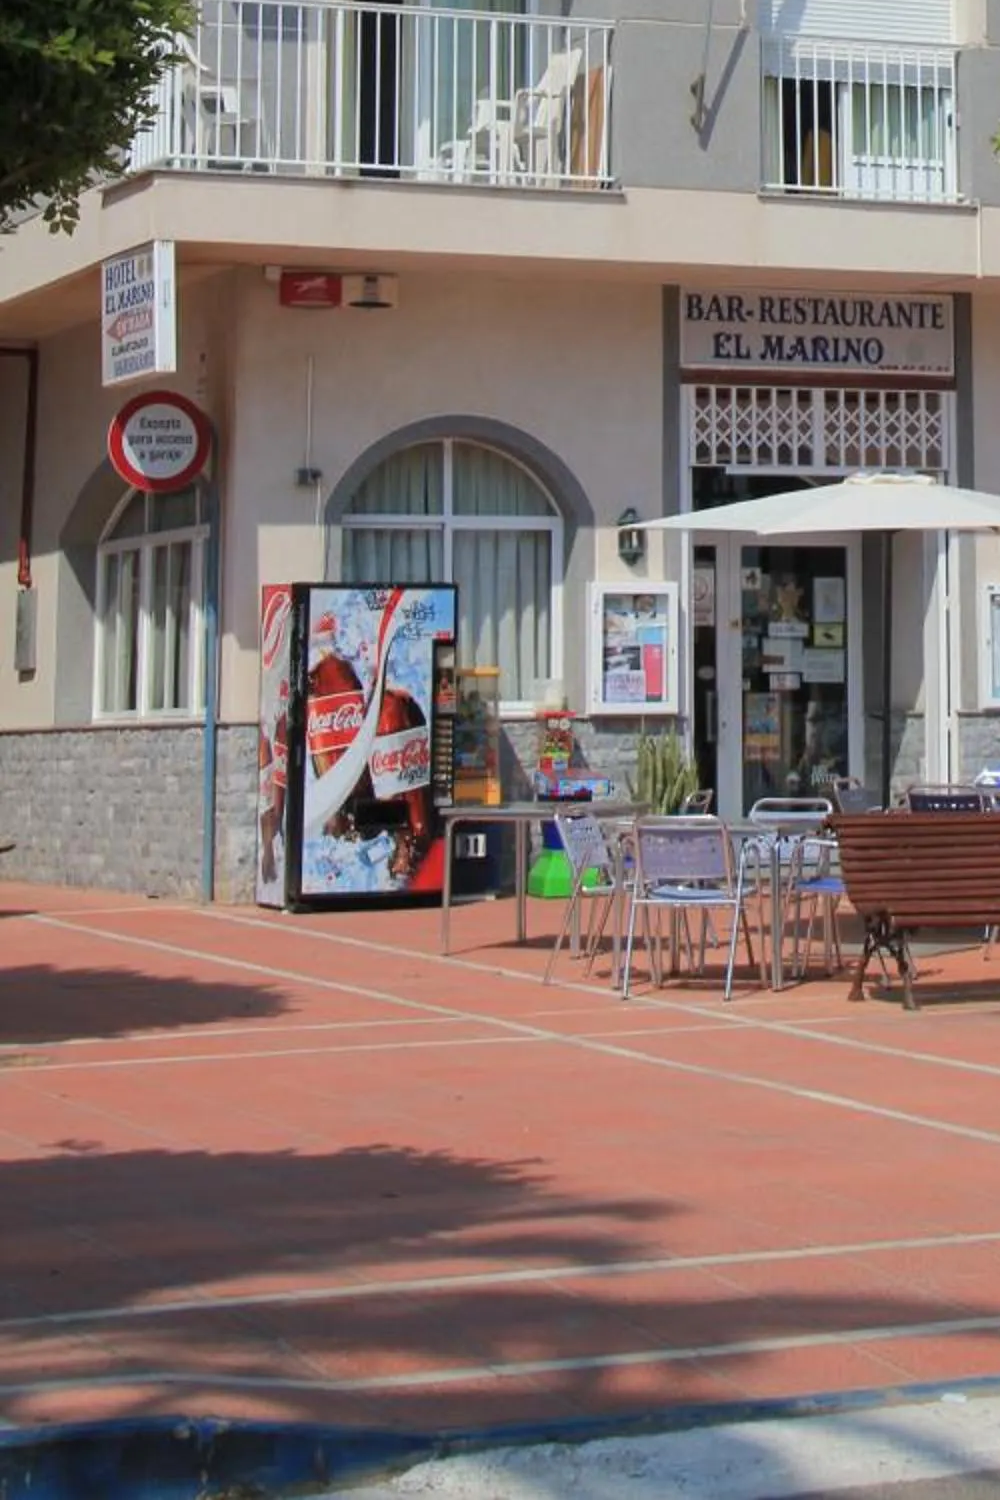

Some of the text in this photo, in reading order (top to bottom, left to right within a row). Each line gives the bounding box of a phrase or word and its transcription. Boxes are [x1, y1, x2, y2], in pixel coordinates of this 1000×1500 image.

[105, 260, 135, 292] HOTEL
[105, 295, 116, 315] EL
[117, 280, 155, 312] MARINO
[713, 331, 885, 365] EL MARINO
[127, 434, 192, 447] para acceso
